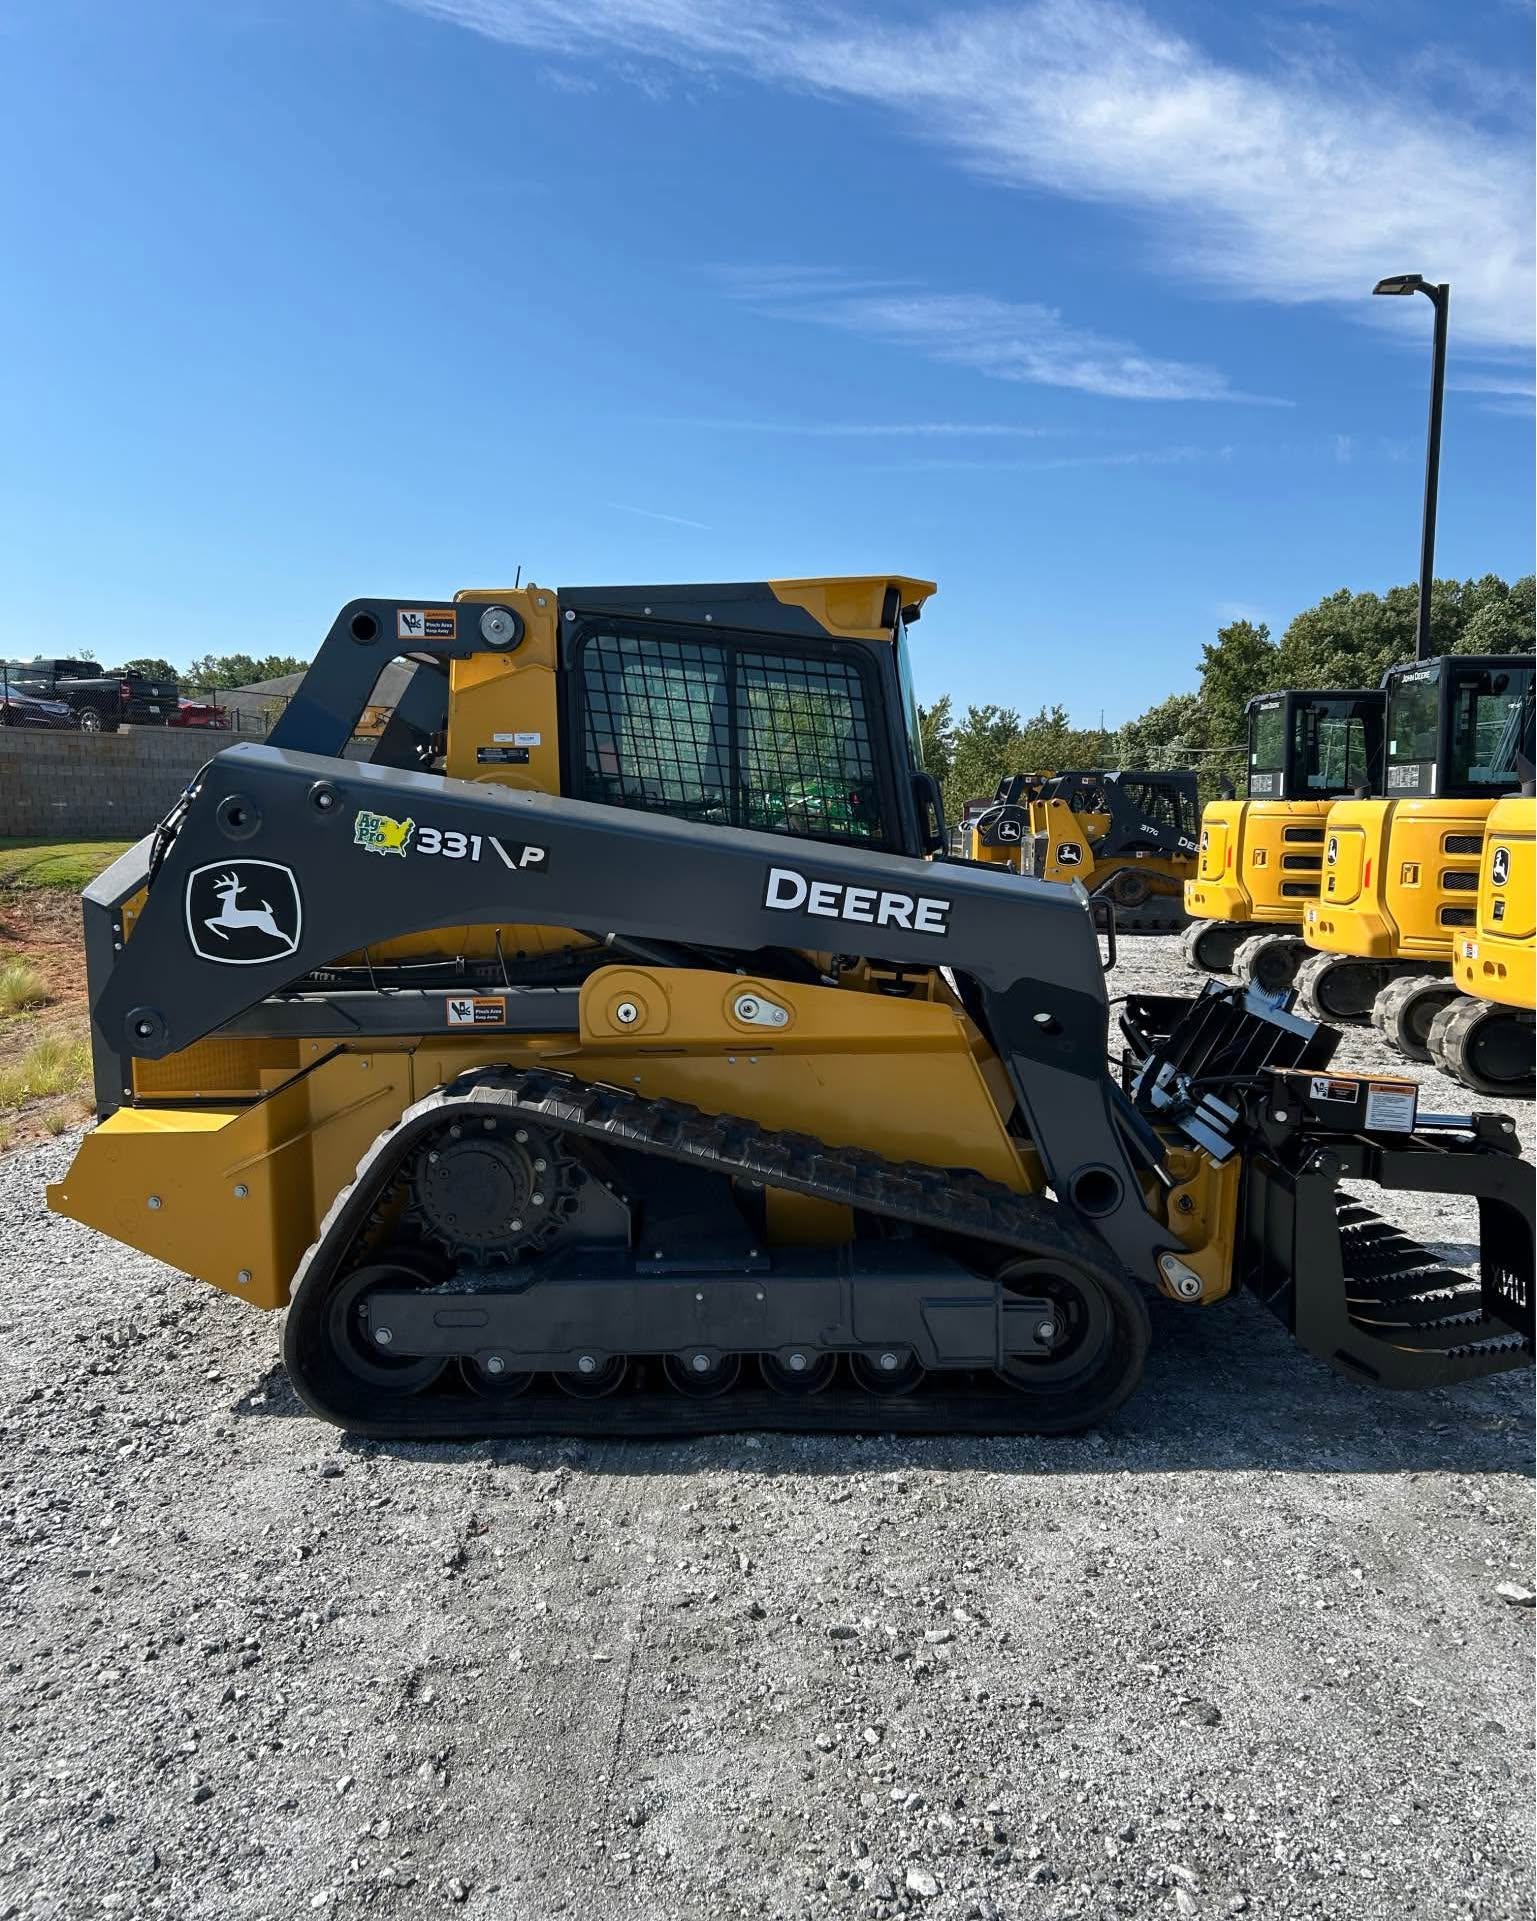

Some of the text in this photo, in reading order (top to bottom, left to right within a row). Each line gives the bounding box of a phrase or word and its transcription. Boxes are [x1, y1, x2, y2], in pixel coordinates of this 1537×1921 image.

[1401, 670, 1431, 684] JOHN DEERE
[358, 828, 386, 843] Pro
[1140, 824, 1159, 836] 317G
[416, 827, 482, 862] 331
[765, 867, 950, 934] DEERE
